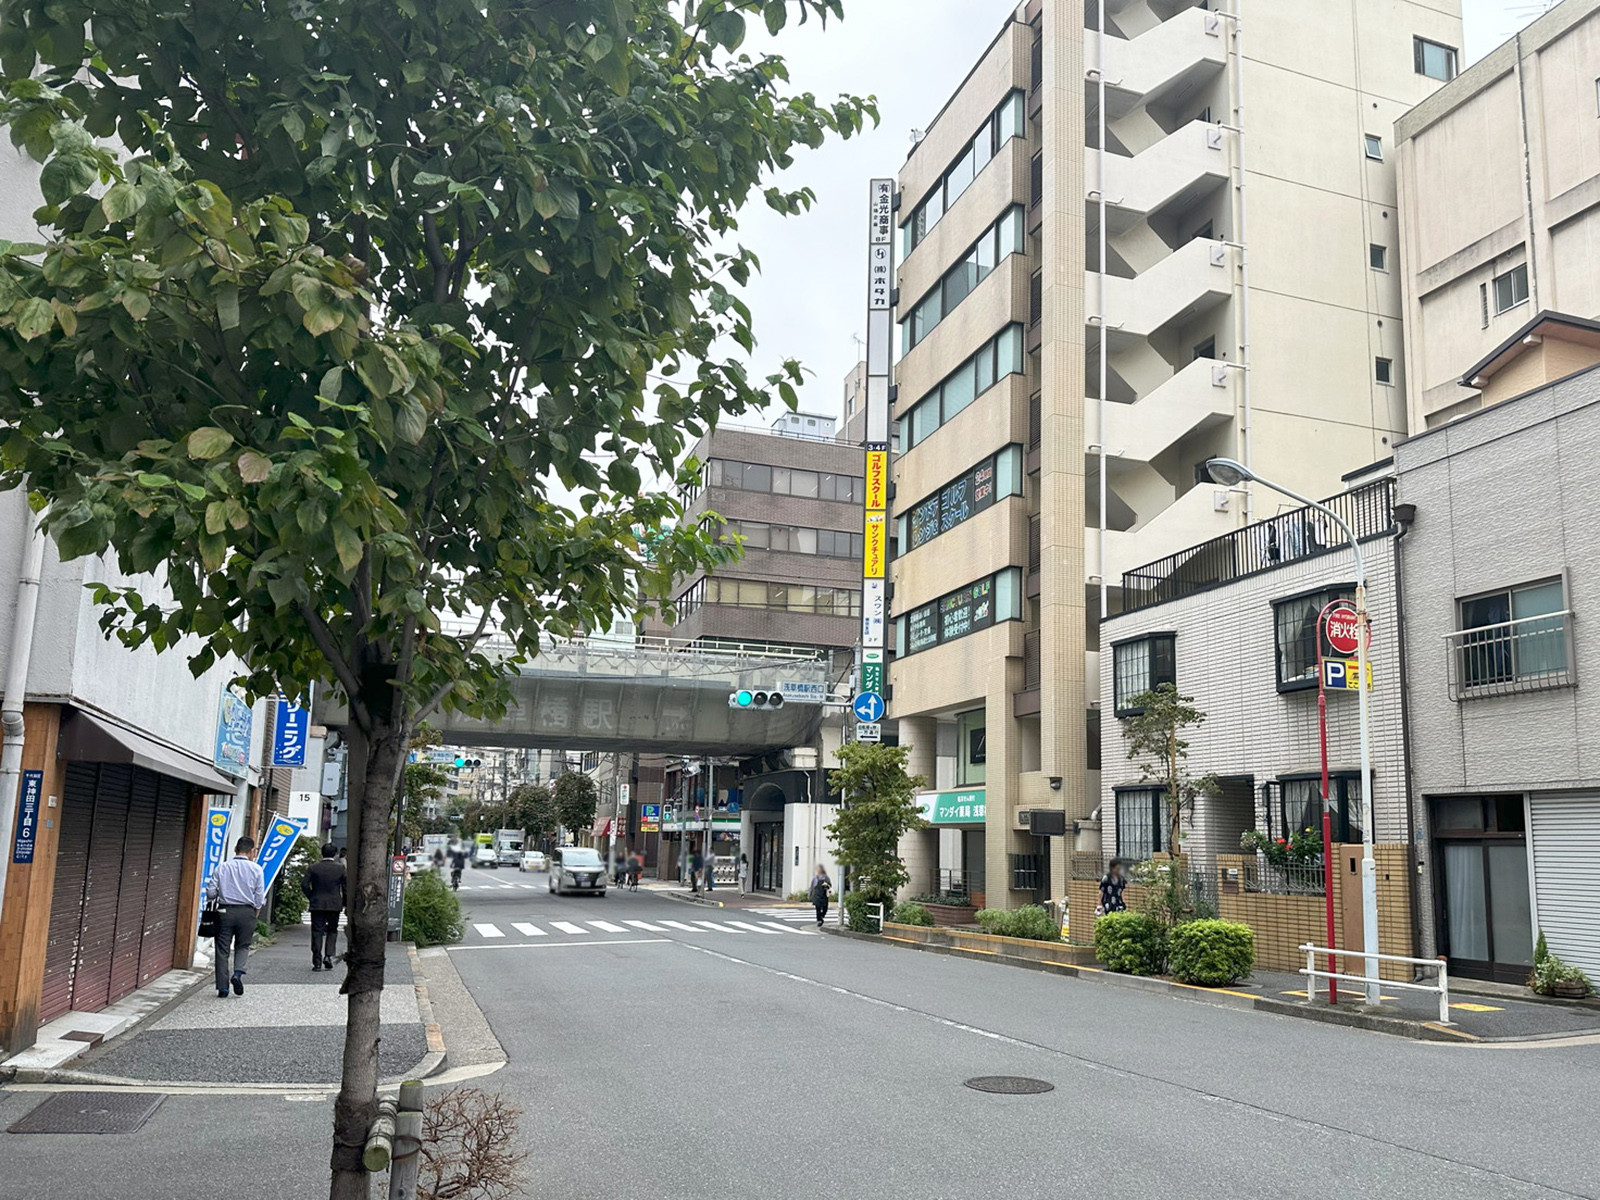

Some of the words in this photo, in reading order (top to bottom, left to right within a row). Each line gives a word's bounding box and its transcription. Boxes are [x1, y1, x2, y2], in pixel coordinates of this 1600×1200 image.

[871, 453, 882, 508] ゴルフスクール
[871, 524, 880, 575] サンクチュアリ
[783, 682, 825, 694] 浅草橋駅西口
[1326, 662, 1345, 685] P
[282, 699, 302, 759] リーニング
[23, 780, 37, 826] 東神田三丁目
[939, 805, 971, 817] マンダイ薬局
[973, 804, 986, 817] 浅草
[22, 828, 30, 838] 6
